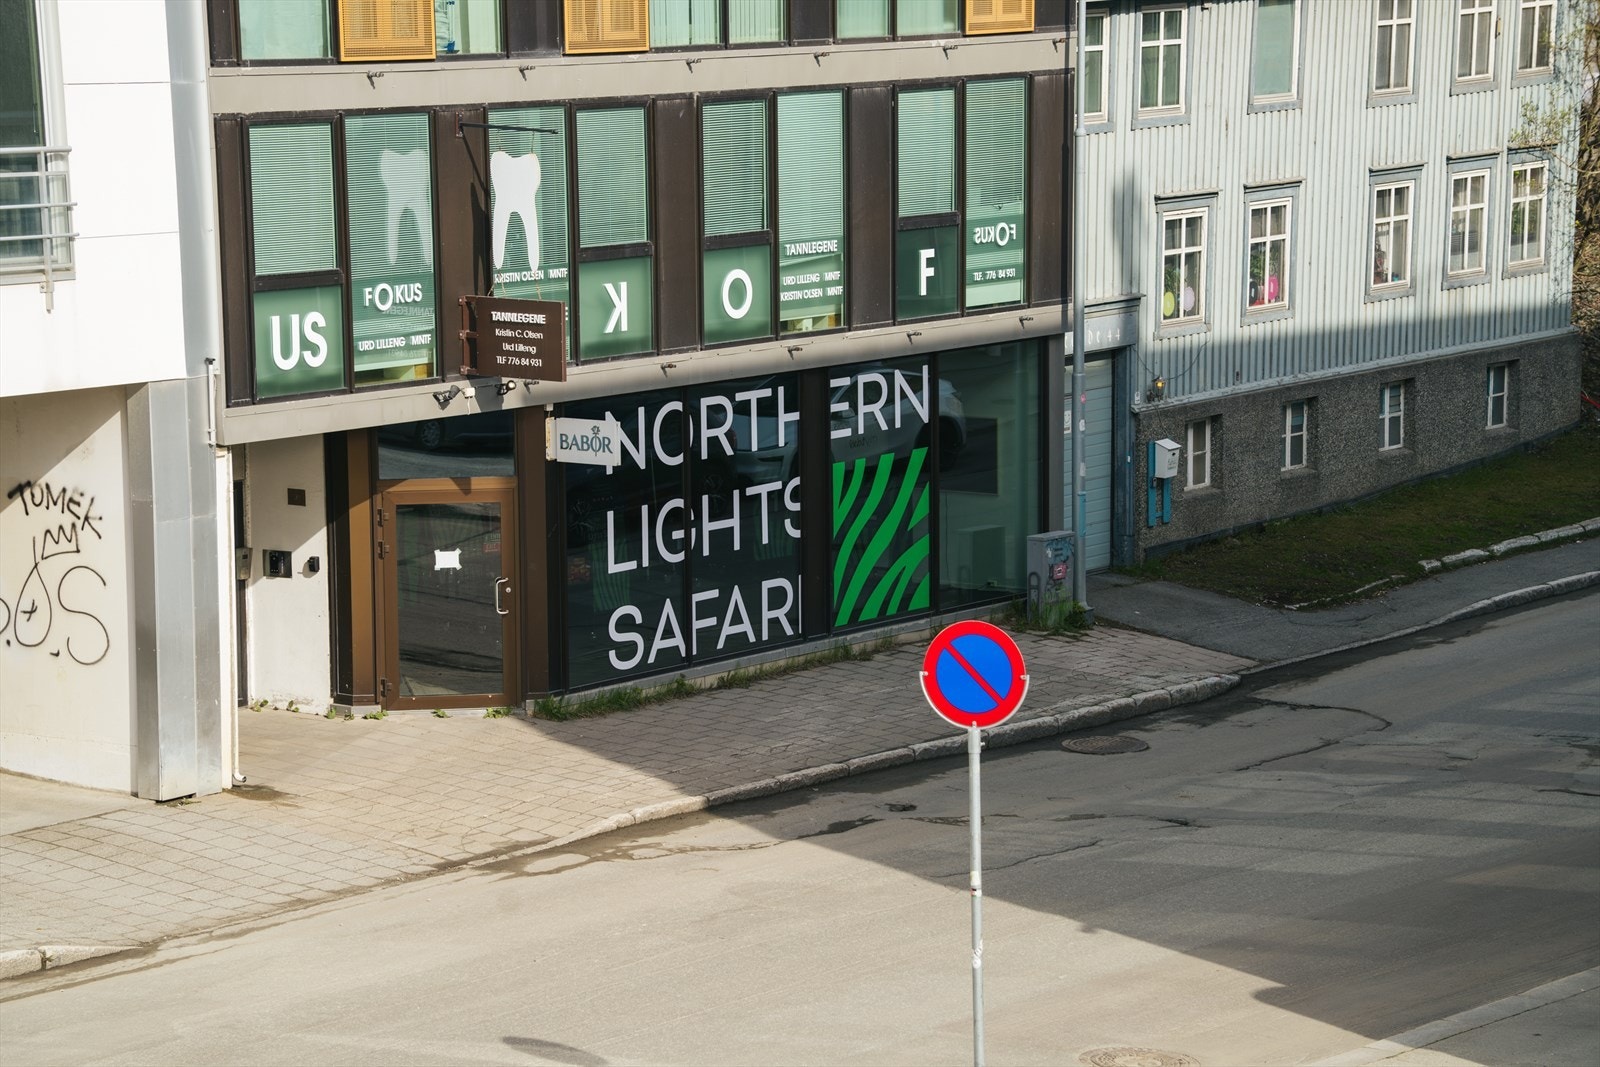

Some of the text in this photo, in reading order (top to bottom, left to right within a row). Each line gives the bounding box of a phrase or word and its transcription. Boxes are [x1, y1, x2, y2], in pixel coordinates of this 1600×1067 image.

[784, 240, 838, 256] TANNLEGENE
[494, 268, 568, 284] KRISTIN OLSEN MNTF
[783, 271, 840, 286] URD LILLENG MNTF
[919, 248, 935, 296] F
[985, 270, 996, 280] 776
[998, 269, 1006, 279] 84
[1006, 268, 1016, 278] 931
[363, 283, 423, 311] FOKUS
[722, 268, 753, 319] O
[780, 286, 843, 301] KRISTIN OLSEN MNTF
[491, 311, 547, 324] TANNLEGENE
[270, 311, 328, 371] US
[495, 328, 543, 339] Kristin C. Olsen
[358, 334, 432, 351] URD LILLENG MNTF
[502, 342, 537, 354] Urd Lilleng
[496, 355, 542, 367] TLF 776 84 931
[560, 433, 614, 454] BABOR
[8, 480, 103, 539] TOMEK
[606, 476, 801, 575] LIGHTS
